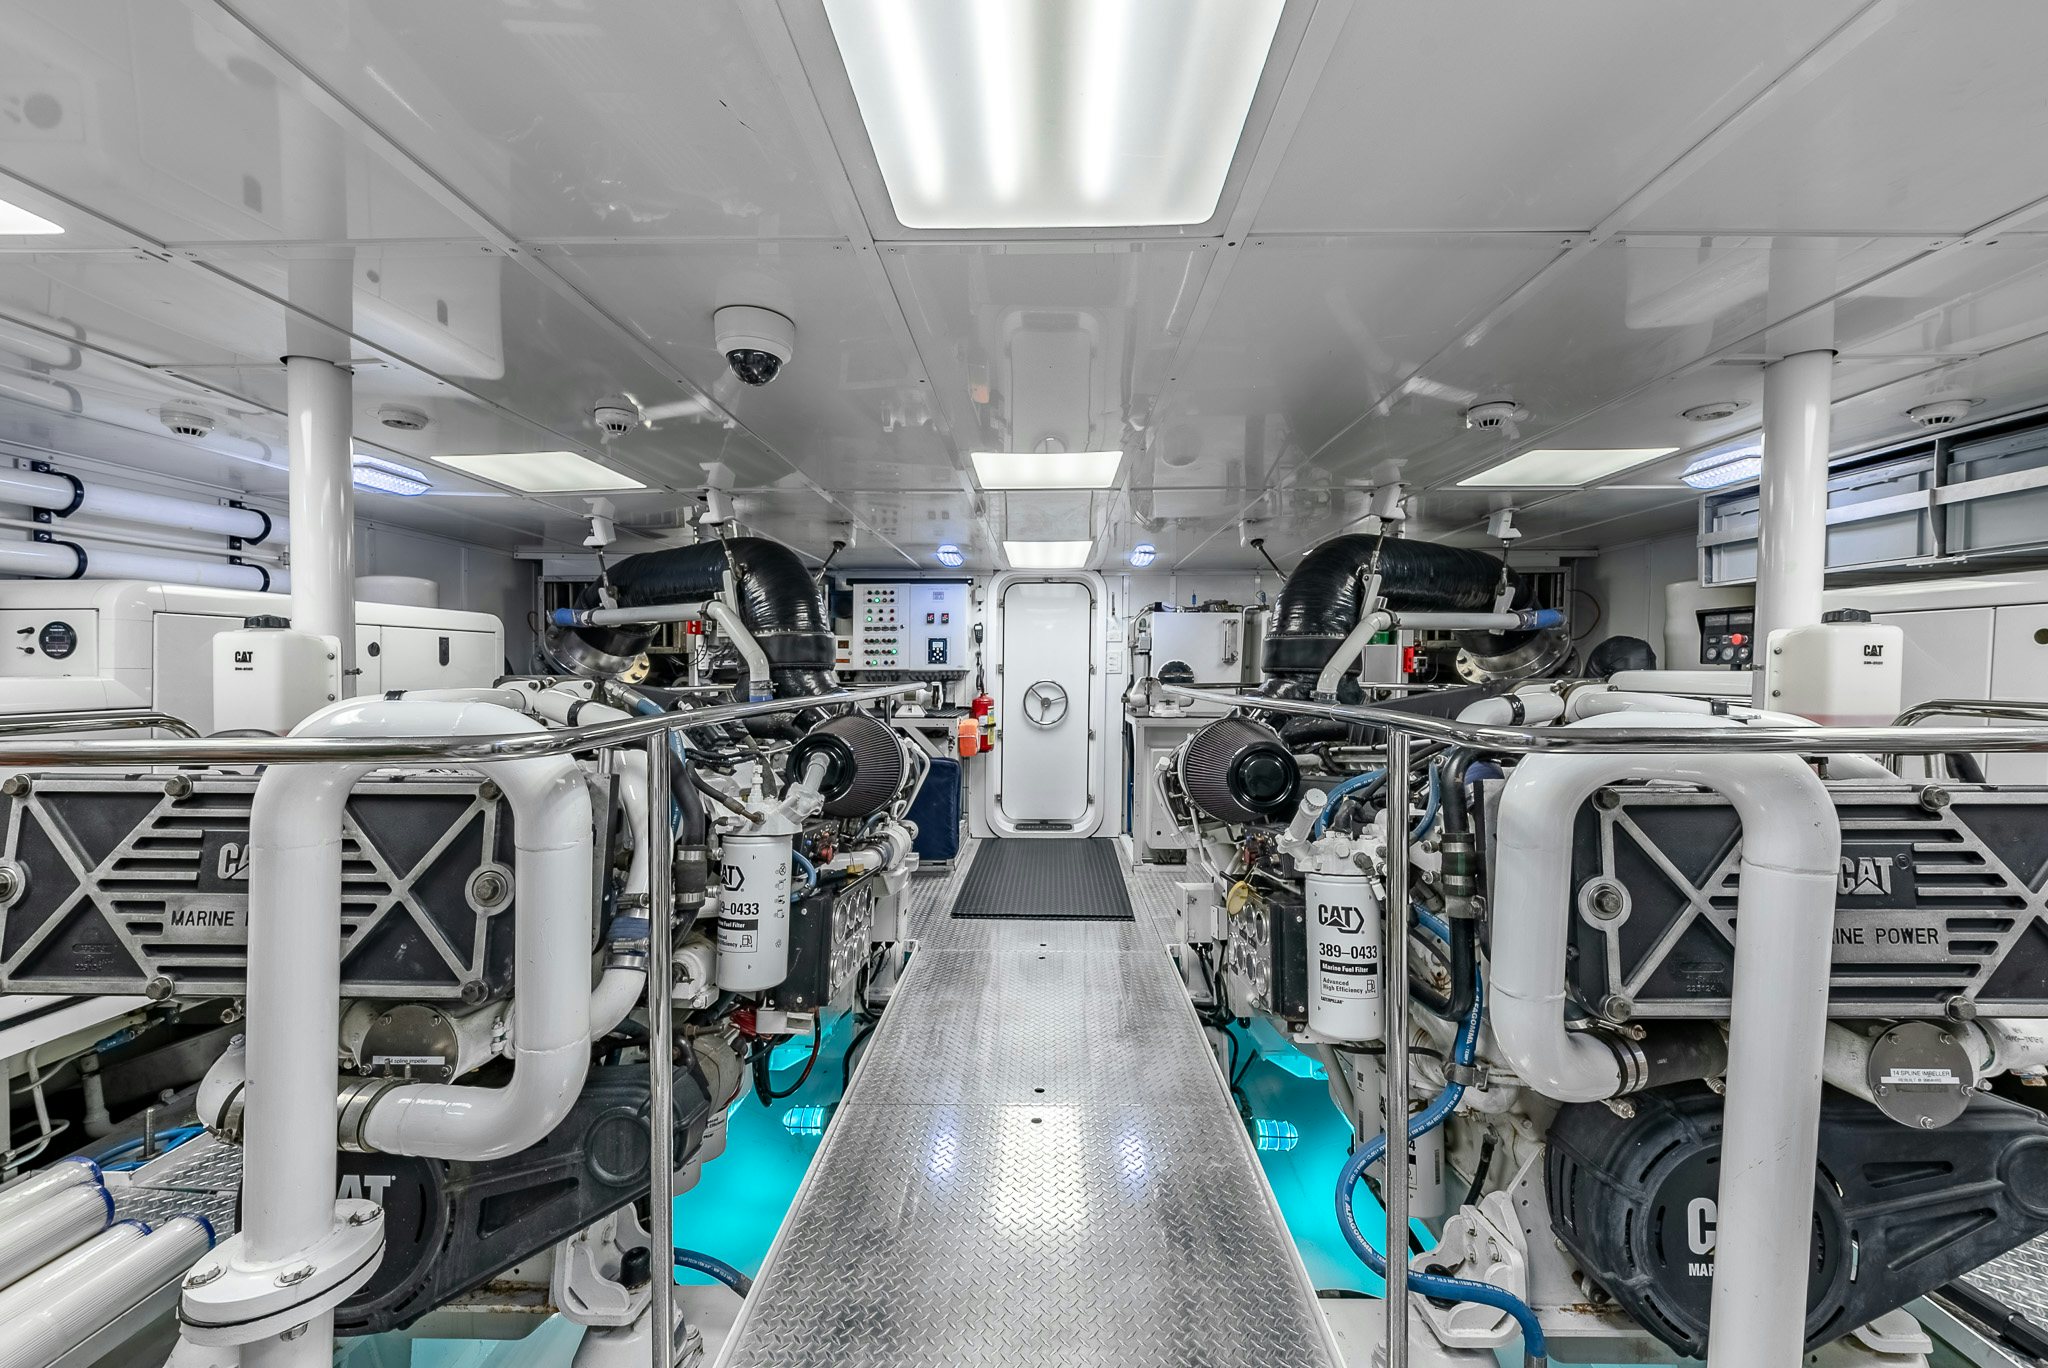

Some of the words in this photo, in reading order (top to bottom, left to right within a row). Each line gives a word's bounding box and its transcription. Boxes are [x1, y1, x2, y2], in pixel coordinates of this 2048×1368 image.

[235, 651, 253, 663] CAT
[1864, 645, 1883, 656] CAT
[1838, 856, 1893, 894] CAT
[171, 910, 235, 926] MARINE
[1318, 904, 1353, 929] CAT
[1876, 927, 1939, 944] POWER
[1319, 942, 1378, 959] 389-0433
[1322, 962, 1341, 972] Marine
[1342, 965, 1354, 973] Fuel
[1323, 977, 1349, 986] Advanced
[1323, 984, 1335, 992] High
[1336, 986, 1363, 994] Efficiency
[337, 1175, 391, 1207] AT
[1344, 1203, 1373, 1255] ALFAGOMMA
